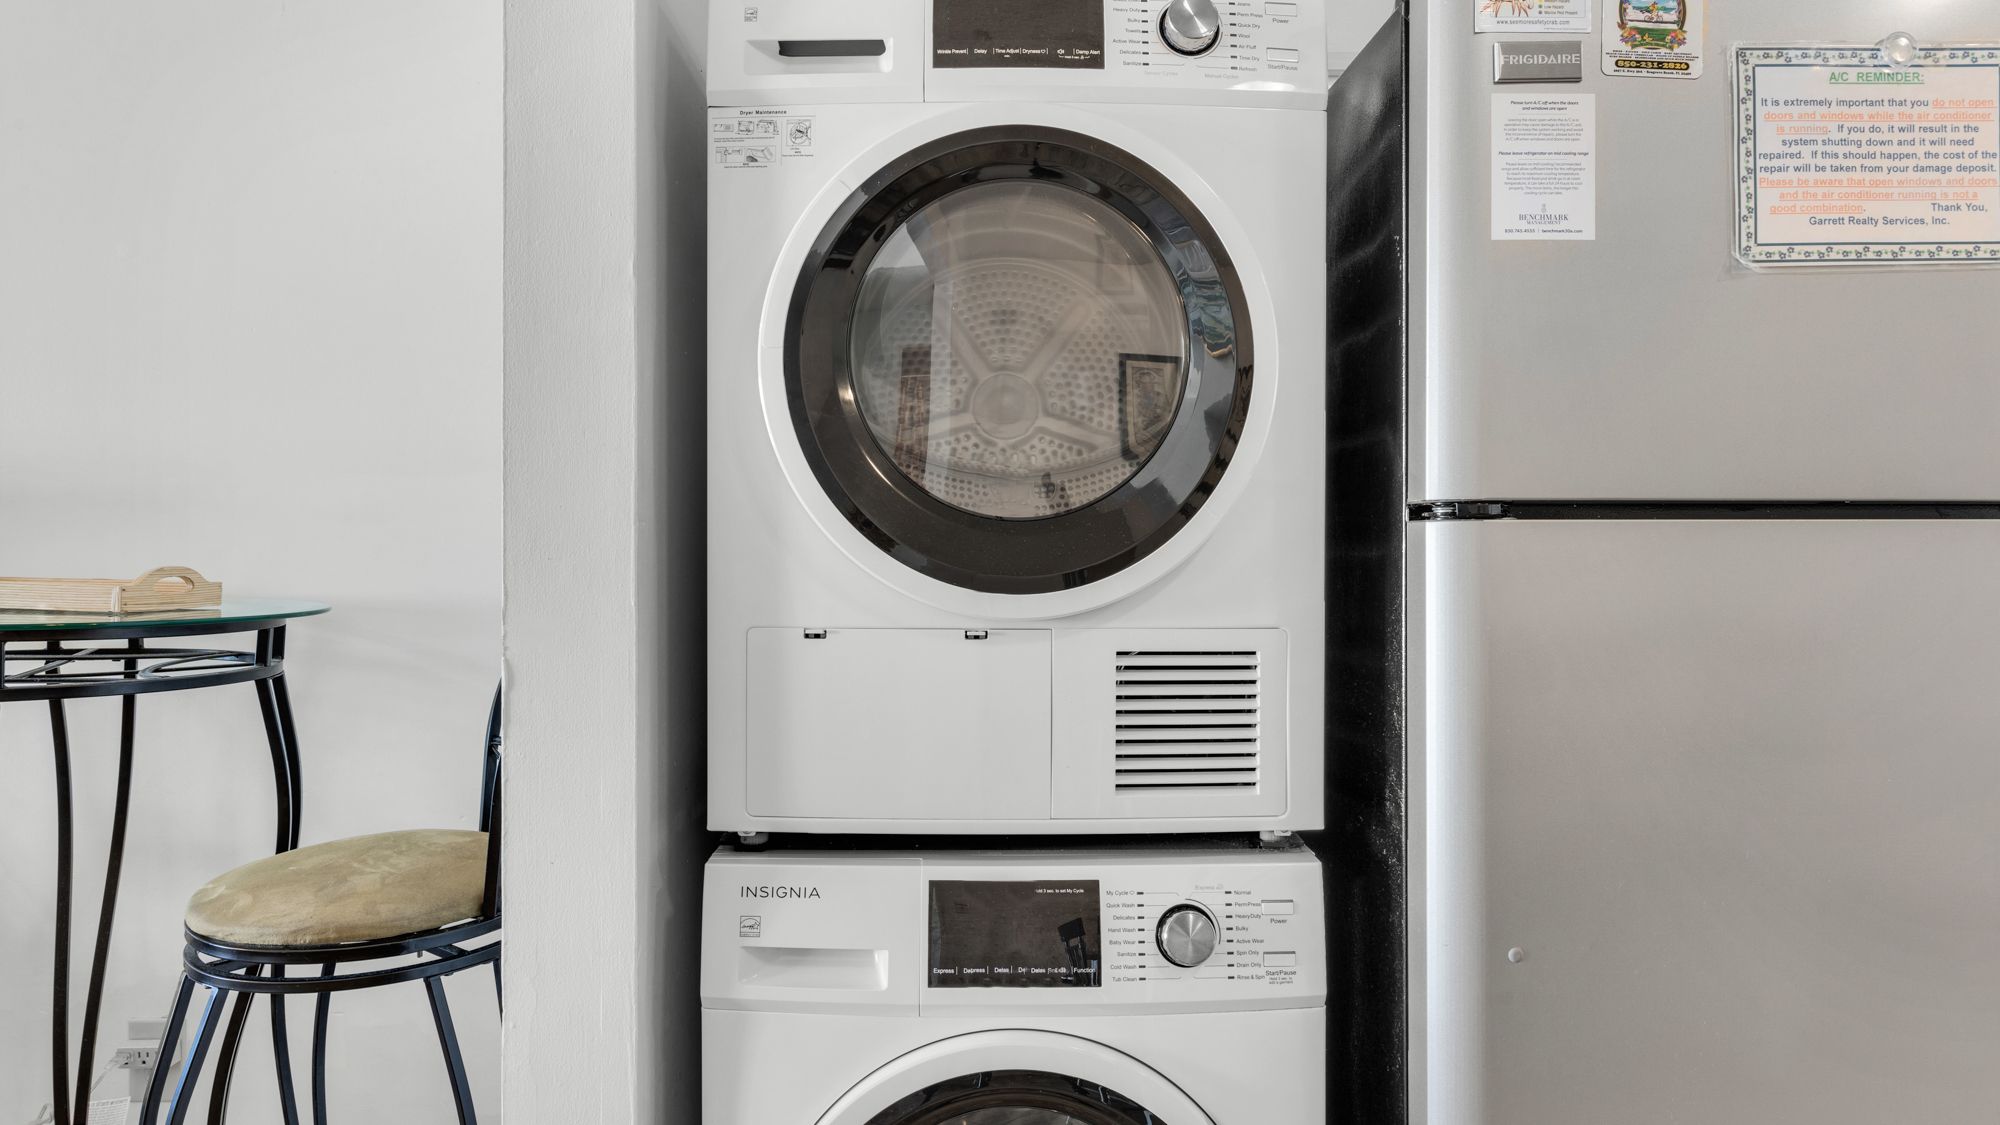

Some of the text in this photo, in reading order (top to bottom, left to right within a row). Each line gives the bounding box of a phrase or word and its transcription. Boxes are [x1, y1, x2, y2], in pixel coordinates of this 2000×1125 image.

[1501, 53, 1580, 65] FRIGIDAIRE
[1617, 60, 1688, 69] 850-231-2826
[1830, 72, 1924, 82] A/C REMINDER:
[1761, 98, 1994, 108] It is extremely important that you do not open
[1764, 111, 1992, 120] doors and windows while the air conditioner
[1789, 125, 1831, 135] running.
[1838, 124, 1844, 133] If
[1847, 126, 1865, 135] you
[1869, 124, 1884, 134] do,
[1888, 124, 1894, 133] it
[1898, 124, 1915, 133] will
[1919, 124, 1947, 133] result
[1951, 124, 1960, 133] in
[1963, 124, 1979, 133] the
[1782, 138, 1974, 148] system shutting down and it will need
[1759, 151, 1997, 161] repaired. If this should happen, the cost of the
[1759, 164, 1996, 174] repair will be taken from your damage deposit.
[1759, 177, 1792, 186] Please
[1797, 177, 1809, 186] be
[1847, 177, 1865, 186] that
[1869, 179, 1894, 187] open
[1896, 177, 1942, 185] windows
[1946, 177, 1964, 185] and
[1968, 177, 1997, 185] doors
[1779, 190, 1798, 199] and
[1802, 190, 1817, 199] the
[1821, 190, 1834, 199] air
[1838, 190, 1894, 199] conditioner
[1898, 190, 1937, 201] running
[1940, 190, 1948, 199] is
[1952, 190, 1969, 199] not
[1770, 204, 1866, 213] good combination.
[1931, 203, 1988, 212] Thank You,
[1809, 216, 1950, 227] Garrett Realty Services, Inc.
[741, 886, 821, 899] INSIGNIA
